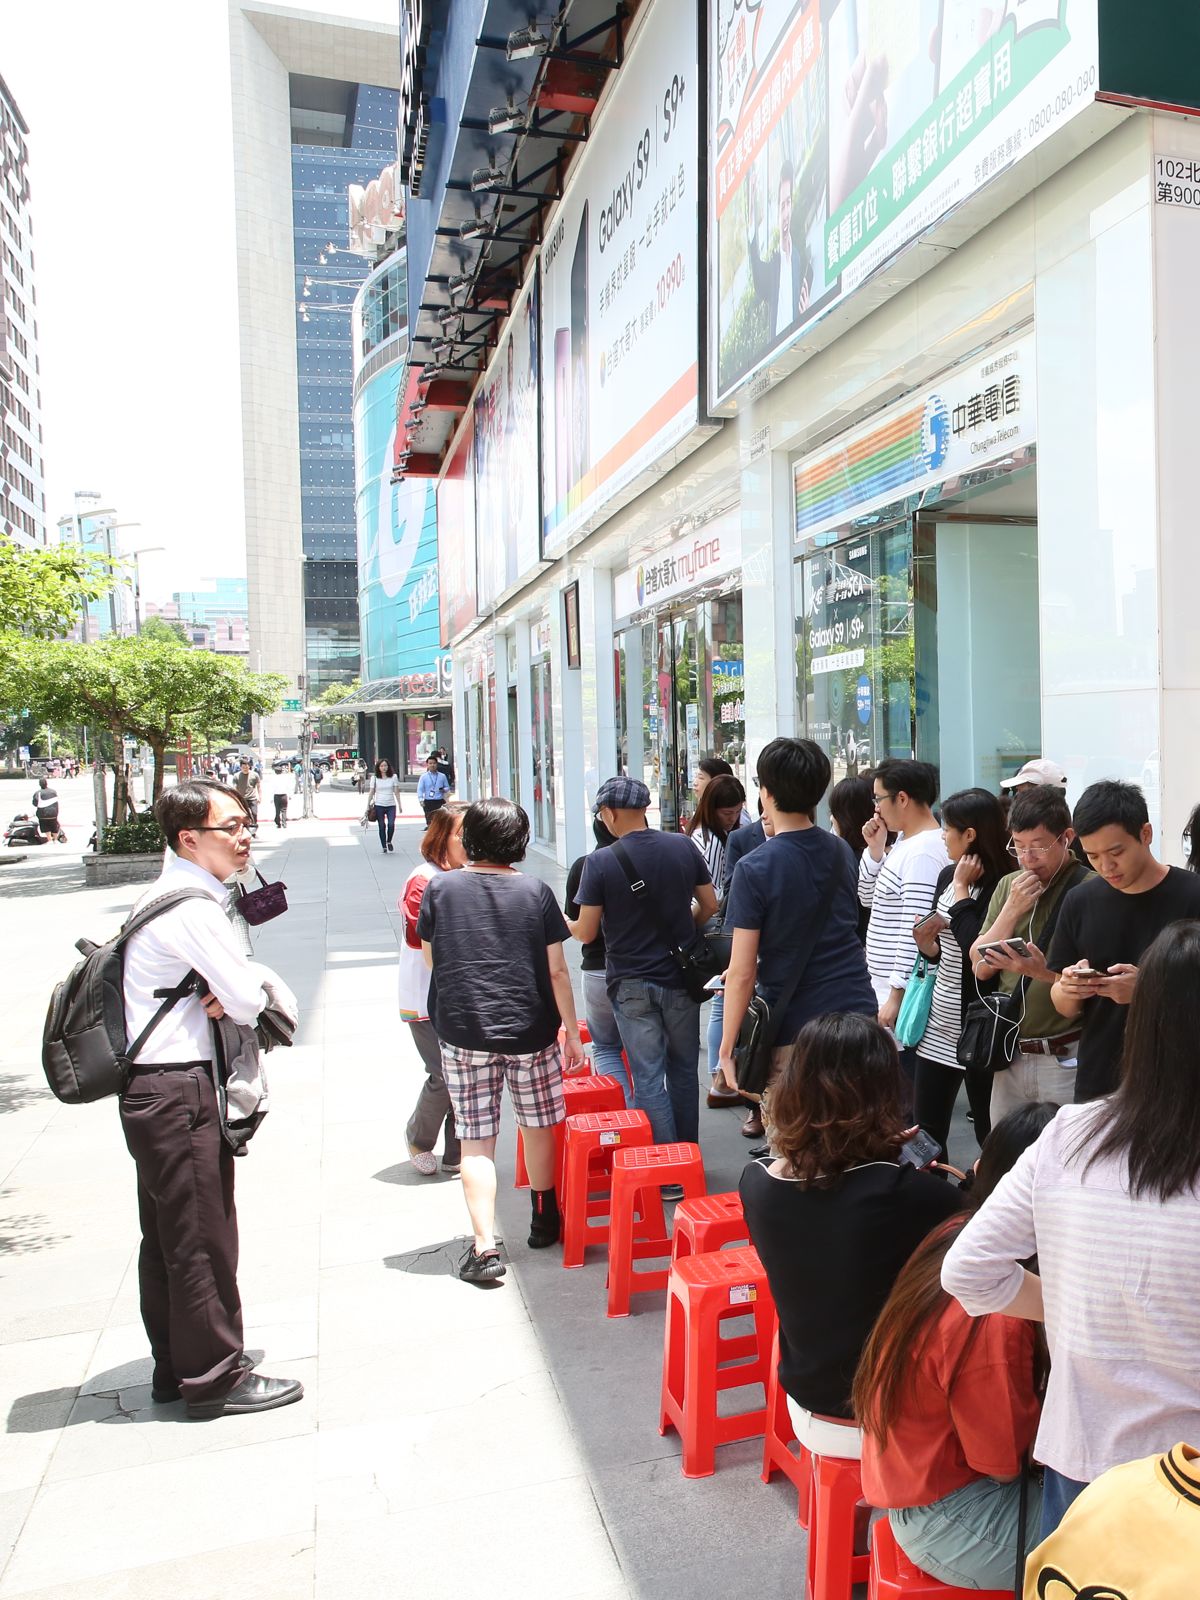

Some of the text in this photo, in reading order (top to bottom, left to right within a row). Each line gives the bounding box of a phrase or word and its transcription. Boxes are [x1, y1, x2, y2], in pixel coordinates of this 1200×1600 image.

[599, 74, 686, 254] Galaxy S9 S9+
[952, 374, 1020, 439] 中華電信
[677, 538, 720, 582] myfone
[848, 545, 867, 560] SAMSUNG
[809, 617, 865, 651] Galaxy S9 S9+
